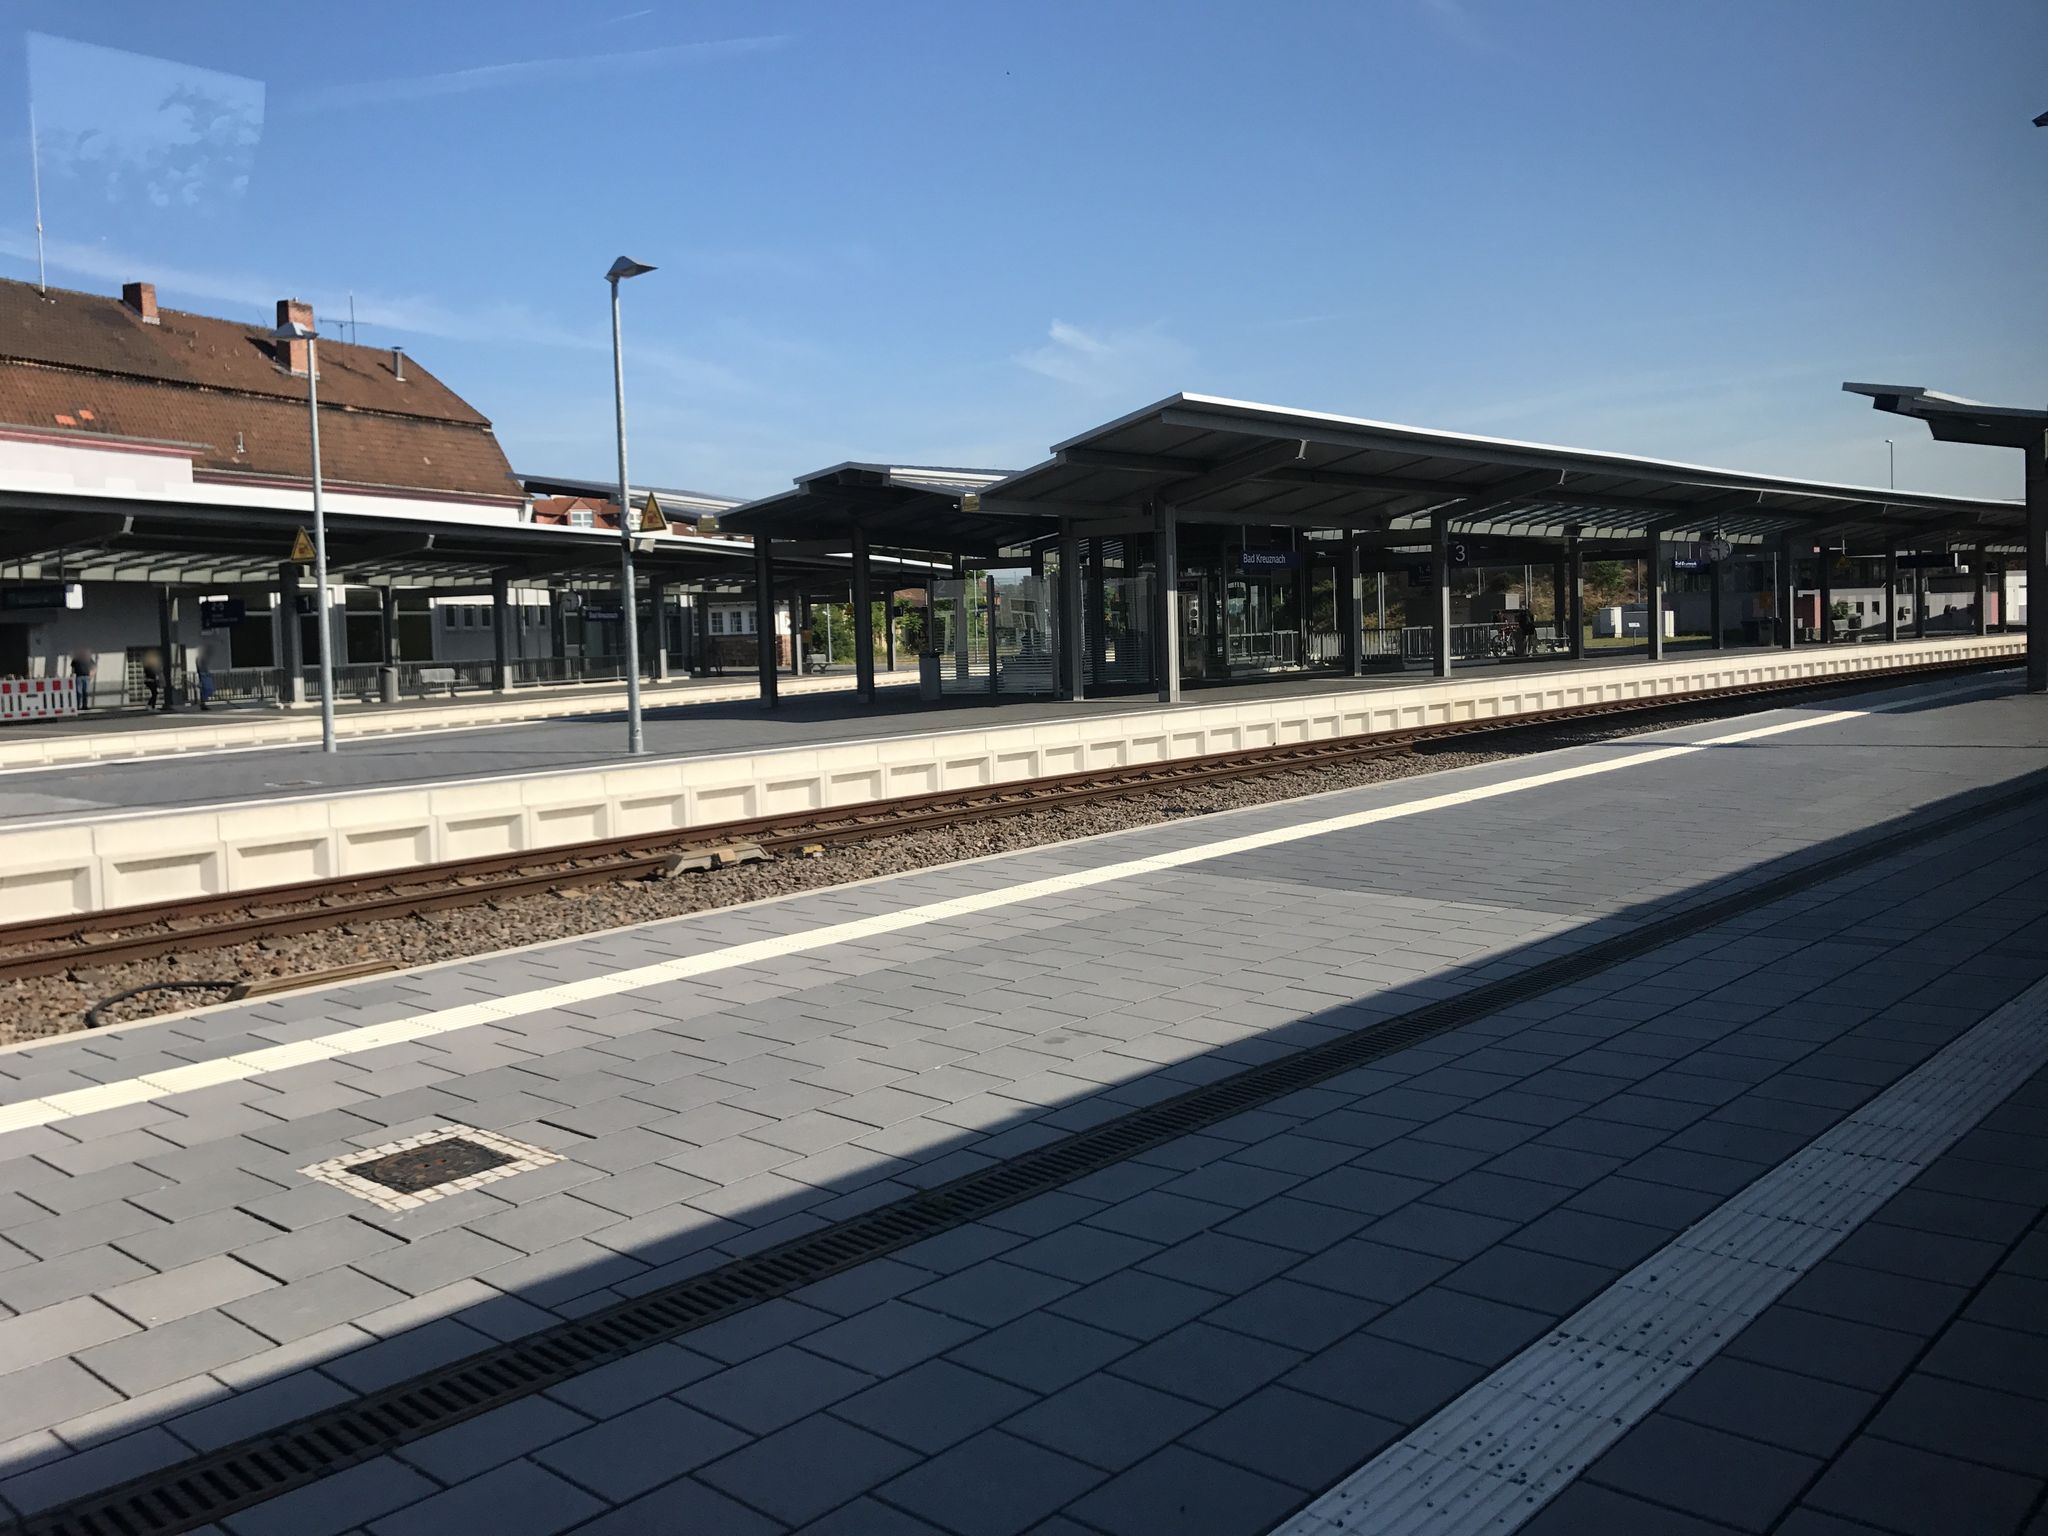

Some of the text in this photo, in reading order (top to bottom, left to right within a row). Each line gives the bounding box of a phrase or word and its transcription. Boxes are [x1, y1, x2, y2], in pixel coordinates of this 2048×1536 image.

[1243, 553, 1286, 564] Bad Kreuznach
[1455, 544, 1466, 562] 3
